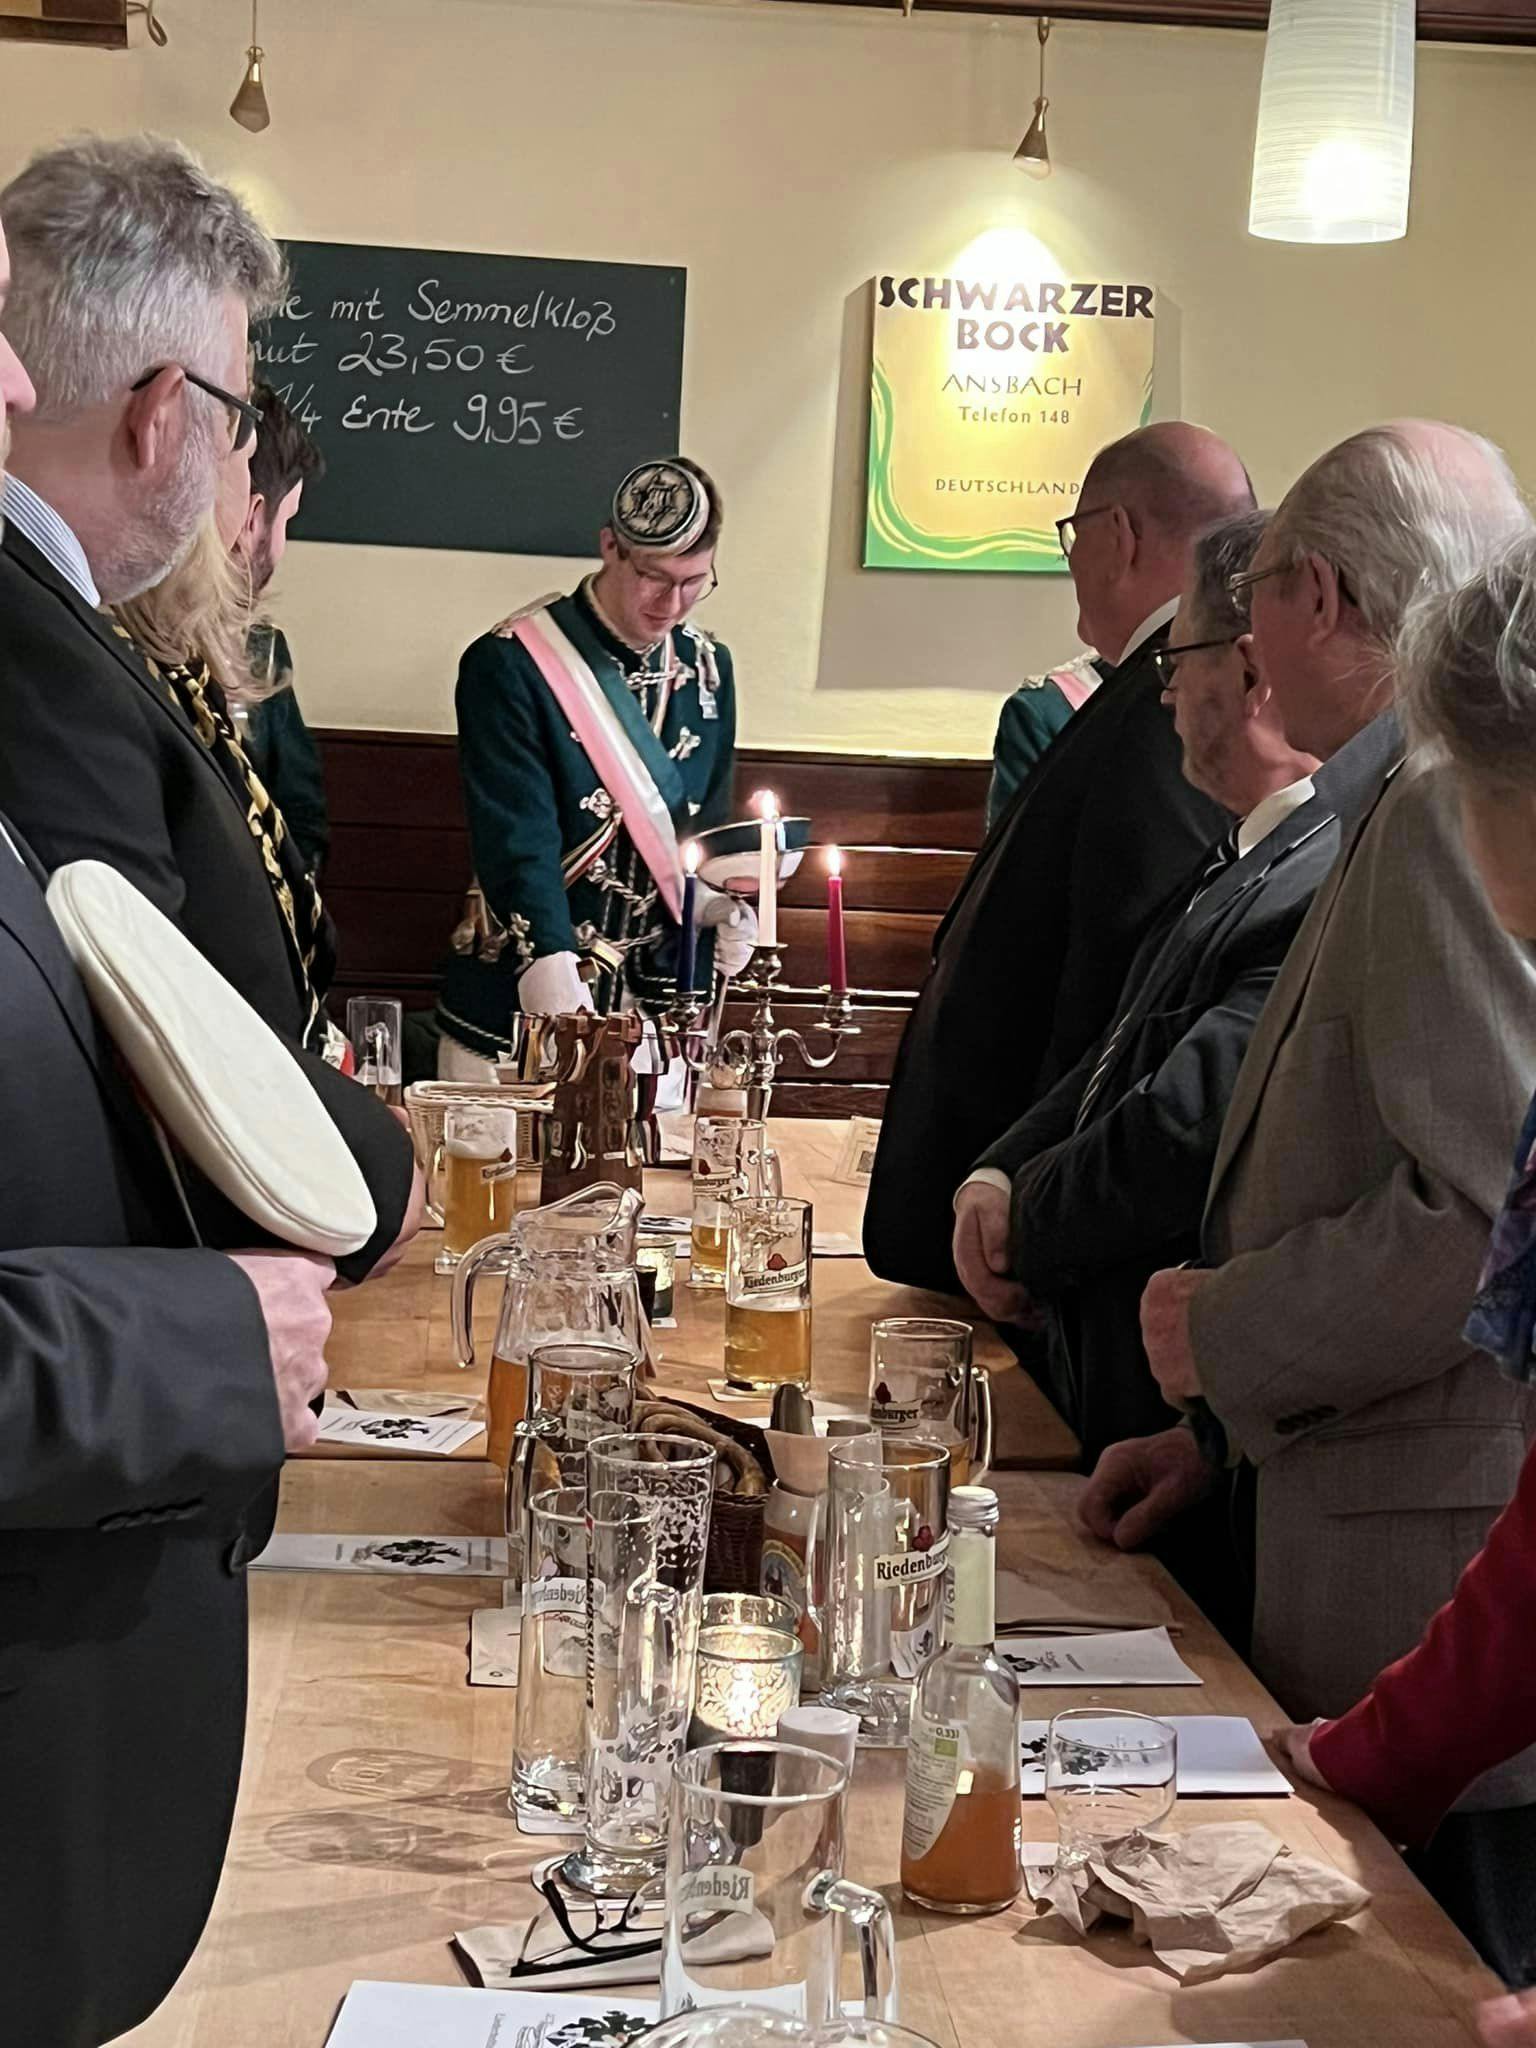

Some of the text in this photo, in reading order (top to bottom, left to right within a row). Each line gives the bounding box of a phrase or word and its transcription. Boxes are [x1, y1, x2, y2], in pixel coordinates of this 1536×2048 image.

[330, 288, 385, 321] mit
[408, 279, 617, 341] Semmelkloß
[878, 275, 1154, 319] SCHWARZER
[338, 331, 485, 376] 23,50
[956, 318, 1071, 353] BOCK
[942, 373, 1082, 396] ANSBACH
[342, 395, 435, 433] Ente
[453, 394, 547, 445] 9,95
[958, 406, 1070, 424] Telefon 148
[935, 478, 1081, 495] DEUTSCHLAND
